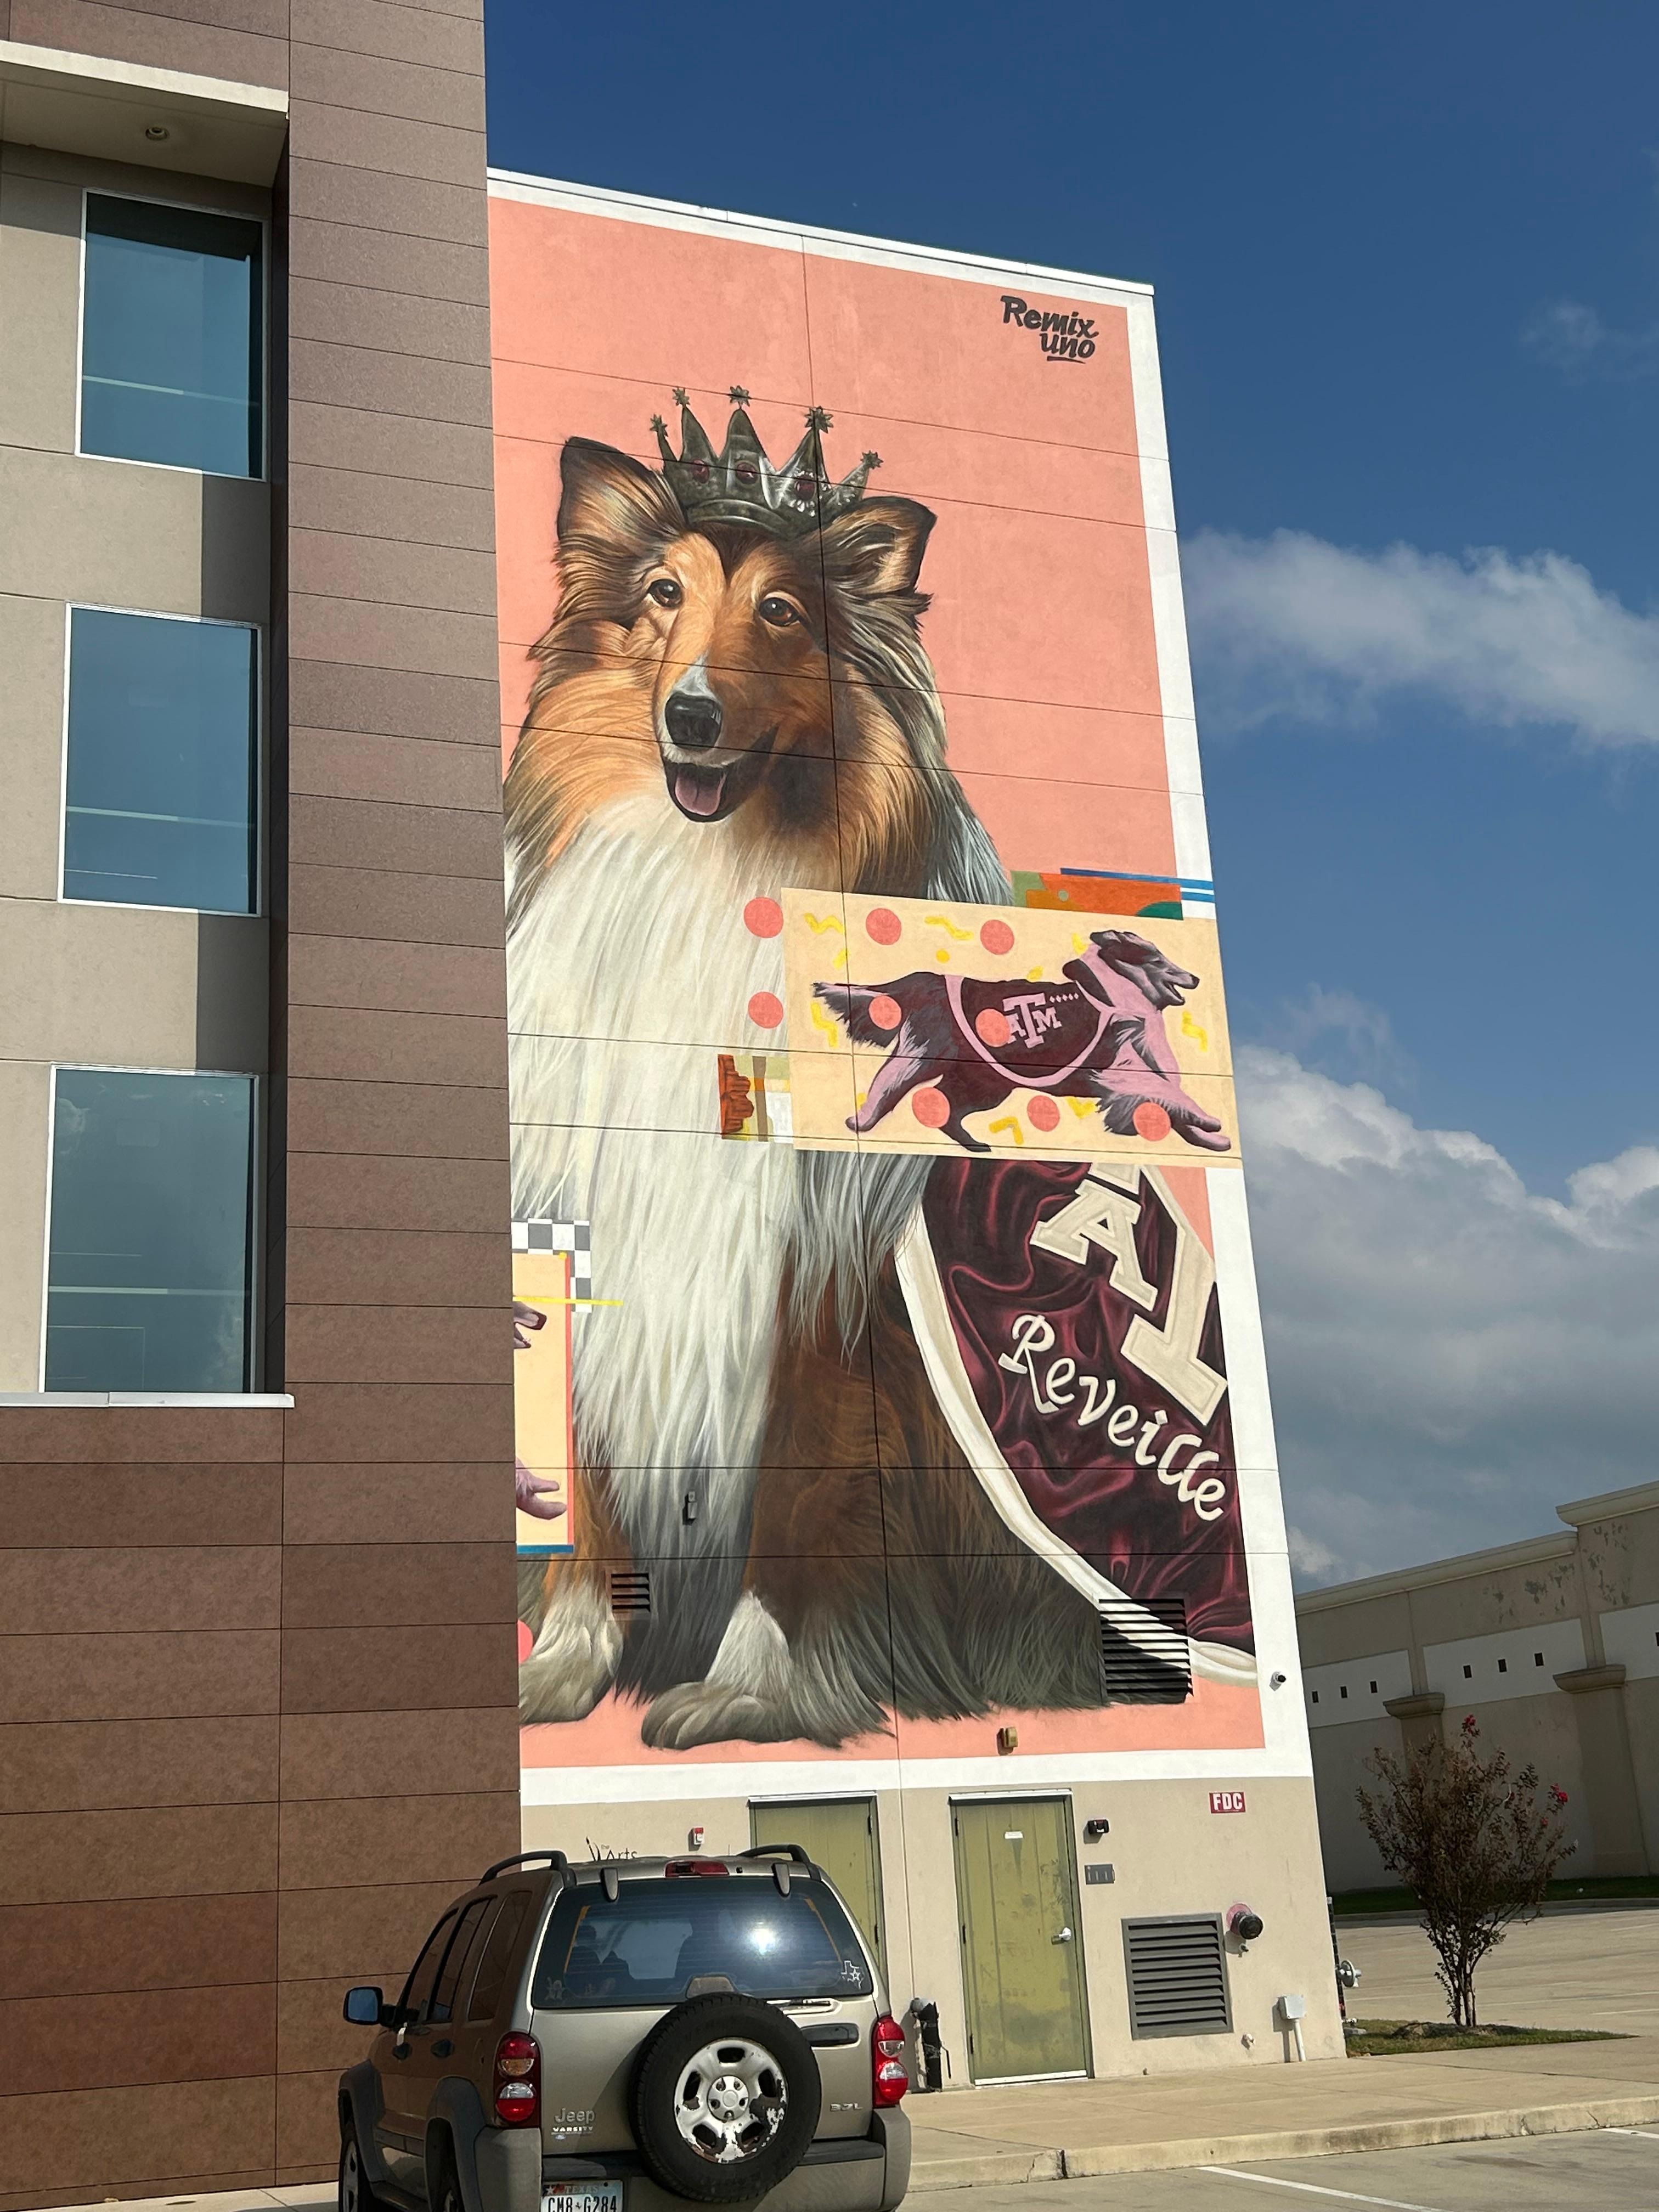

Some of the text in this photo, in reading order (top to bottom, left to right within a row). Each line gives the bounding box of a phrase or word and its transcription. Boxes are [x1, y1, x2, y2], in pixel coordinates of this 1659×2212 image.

[1001, 295, 1099, 338] Remix
[998, 1314, 1226, 1520] Reveille
[1213, 1793, 1243, 1810] FDC
[555, 2107, 595, 2124] Jeep
[565, 2185, 599, 2194] TEXAS
